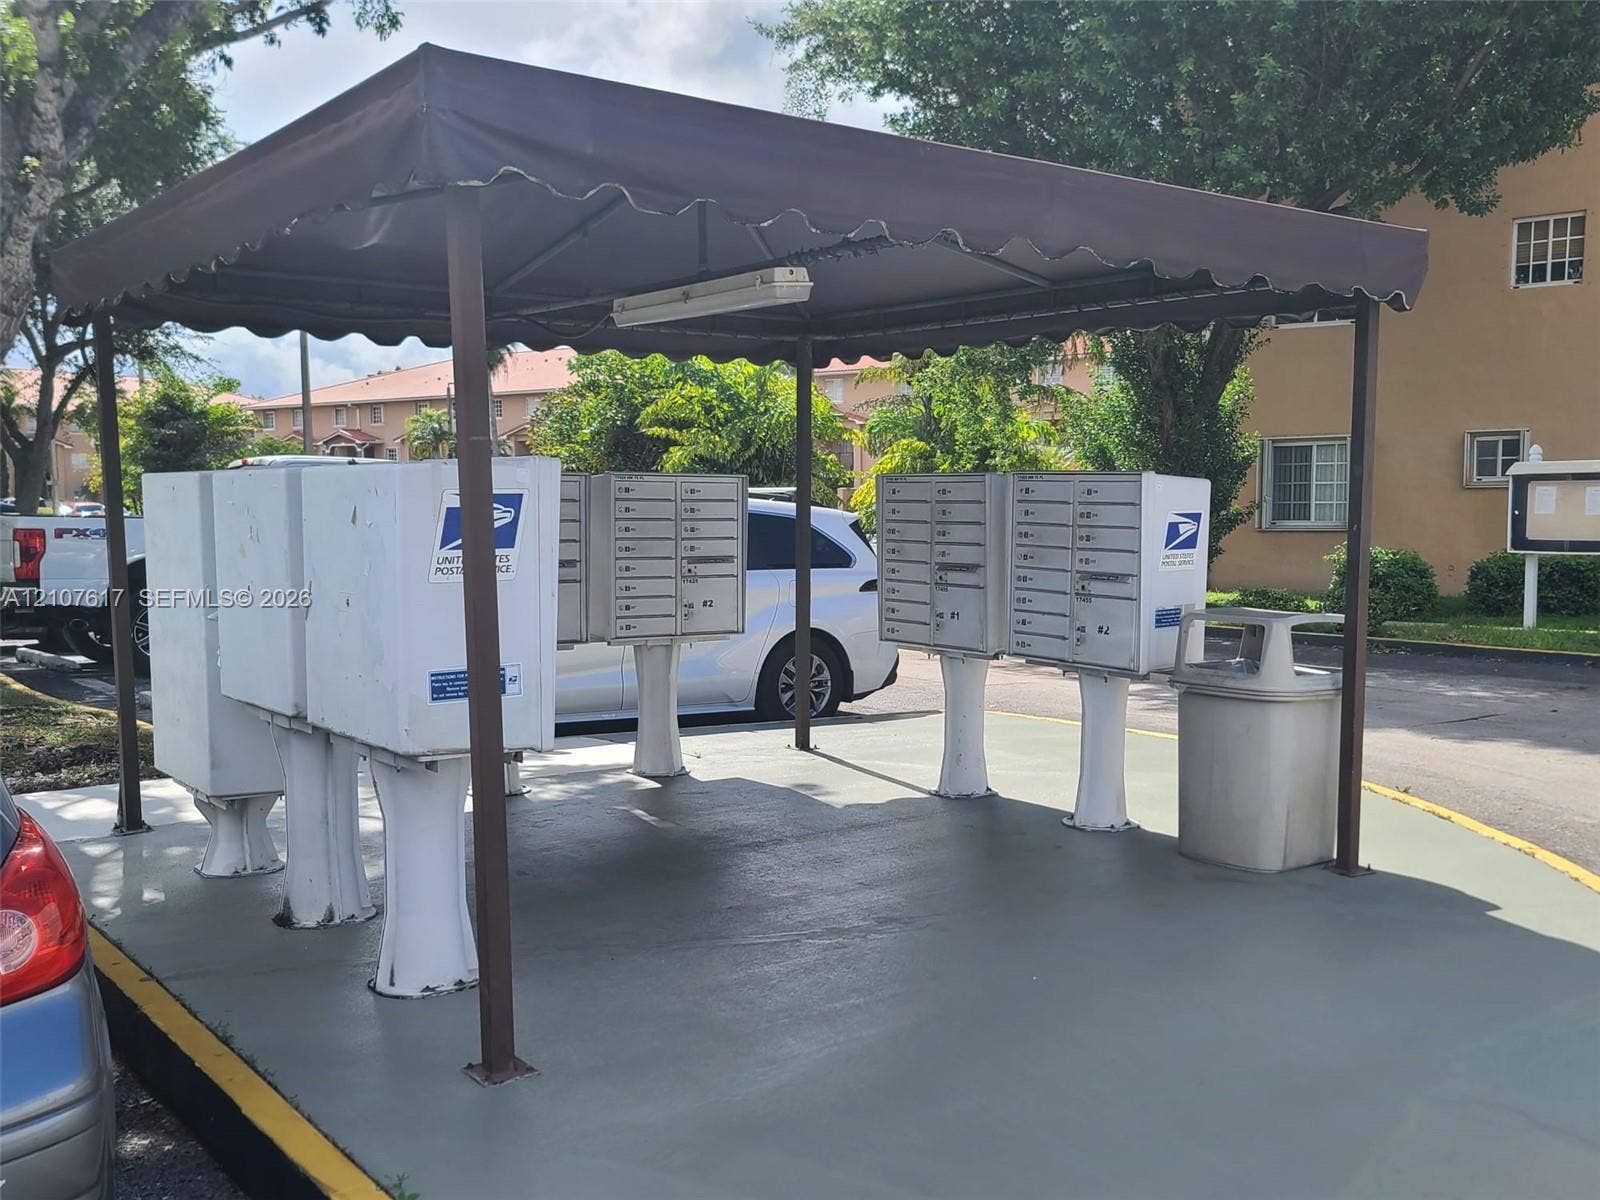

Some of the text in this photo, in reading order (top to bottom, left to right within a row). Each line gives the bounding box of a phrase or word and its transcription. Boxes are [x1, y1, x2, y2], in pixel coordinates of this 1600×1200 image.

[436, 555, 463, 565] UNIT
[434, 566, 464, 576] POSTA
[702, 599, 714, 608] #2
[950, 611, 960, 620] #1
[1097, 625, 1110, 636] #2
